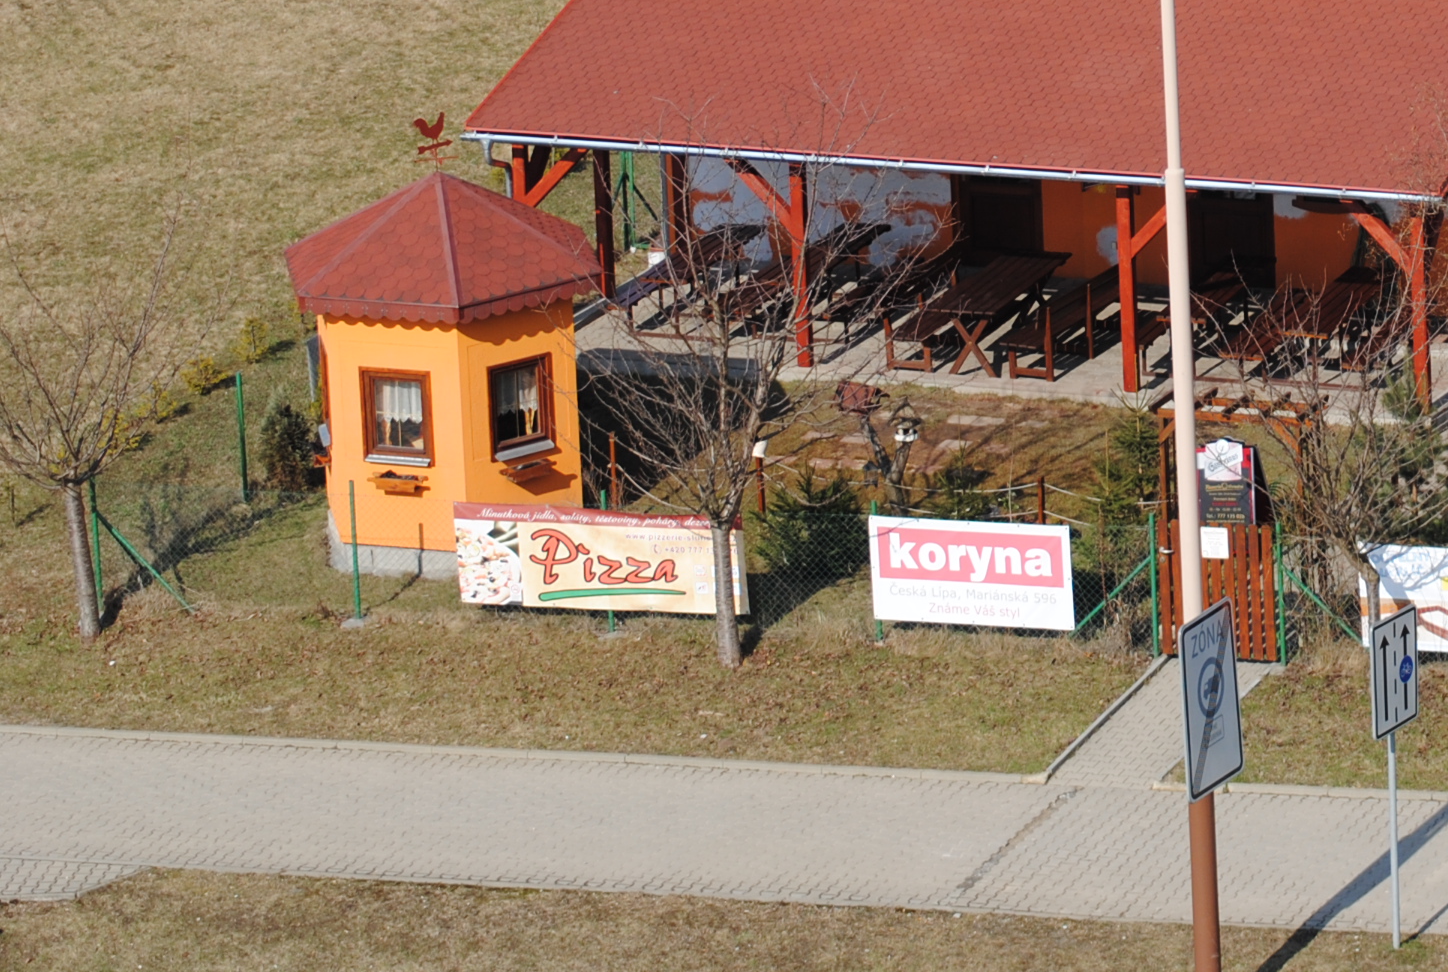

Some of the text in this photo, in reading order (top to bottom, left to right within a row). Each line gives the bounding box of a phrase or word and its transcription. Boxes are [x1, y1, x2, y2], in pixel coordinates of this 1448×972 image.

[530, 528, 678, 585] Pizza
[888, 532, 1052, 582] koryna
[889, 581, 1057, 605] Česká Lípa, Mariánská 596
[928, 602, 1021, 620] Známe Váš styl
[1191, 620, 1225, 659] ZÓNA
